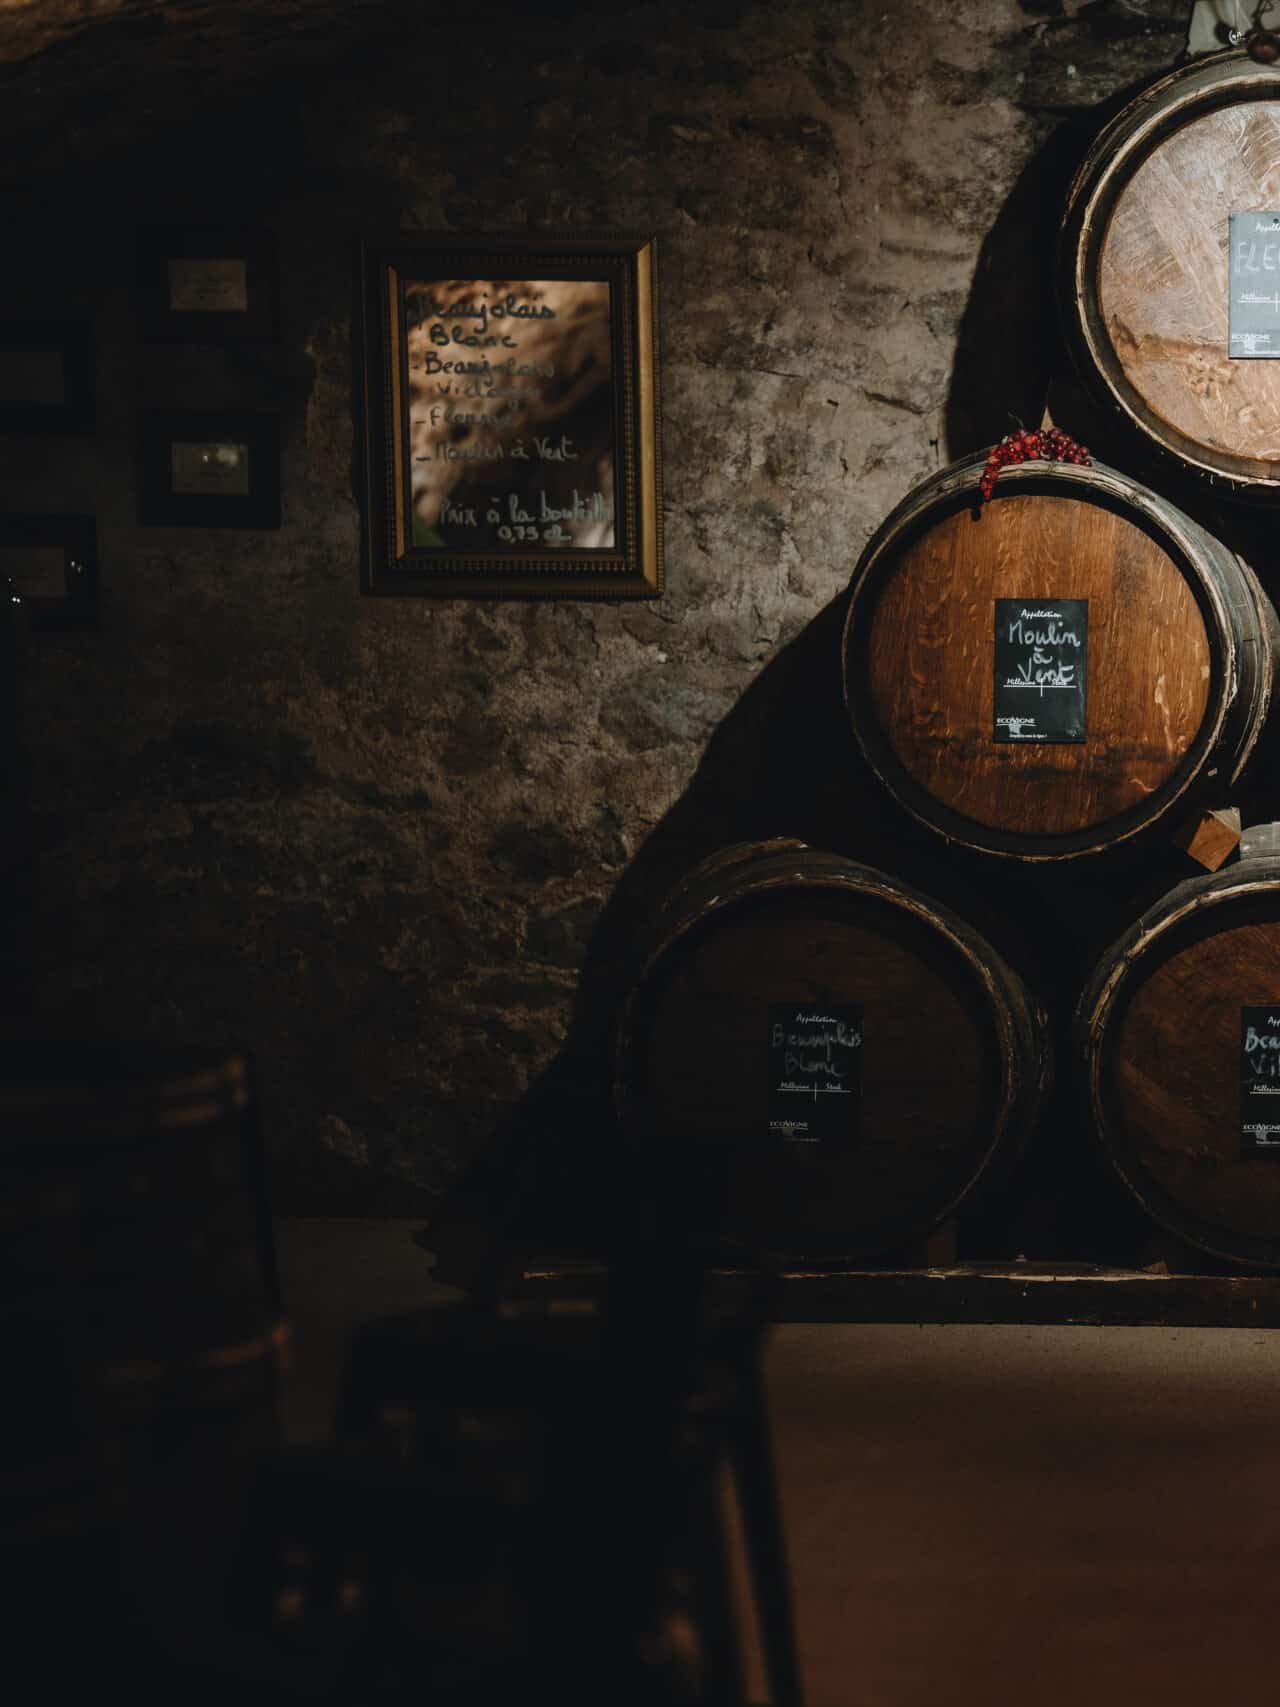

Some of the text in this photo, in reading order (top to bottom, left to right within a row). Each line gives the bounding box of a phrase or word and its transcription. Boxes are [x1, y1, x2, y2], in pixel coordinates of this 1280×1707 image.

[430, 323, 518, 348] Blanc
[1020, 608, 1063, 620] Appellation
[1008, 619, 1081, 648] Moulin
[1016, 656, 1075, 683] Vent
